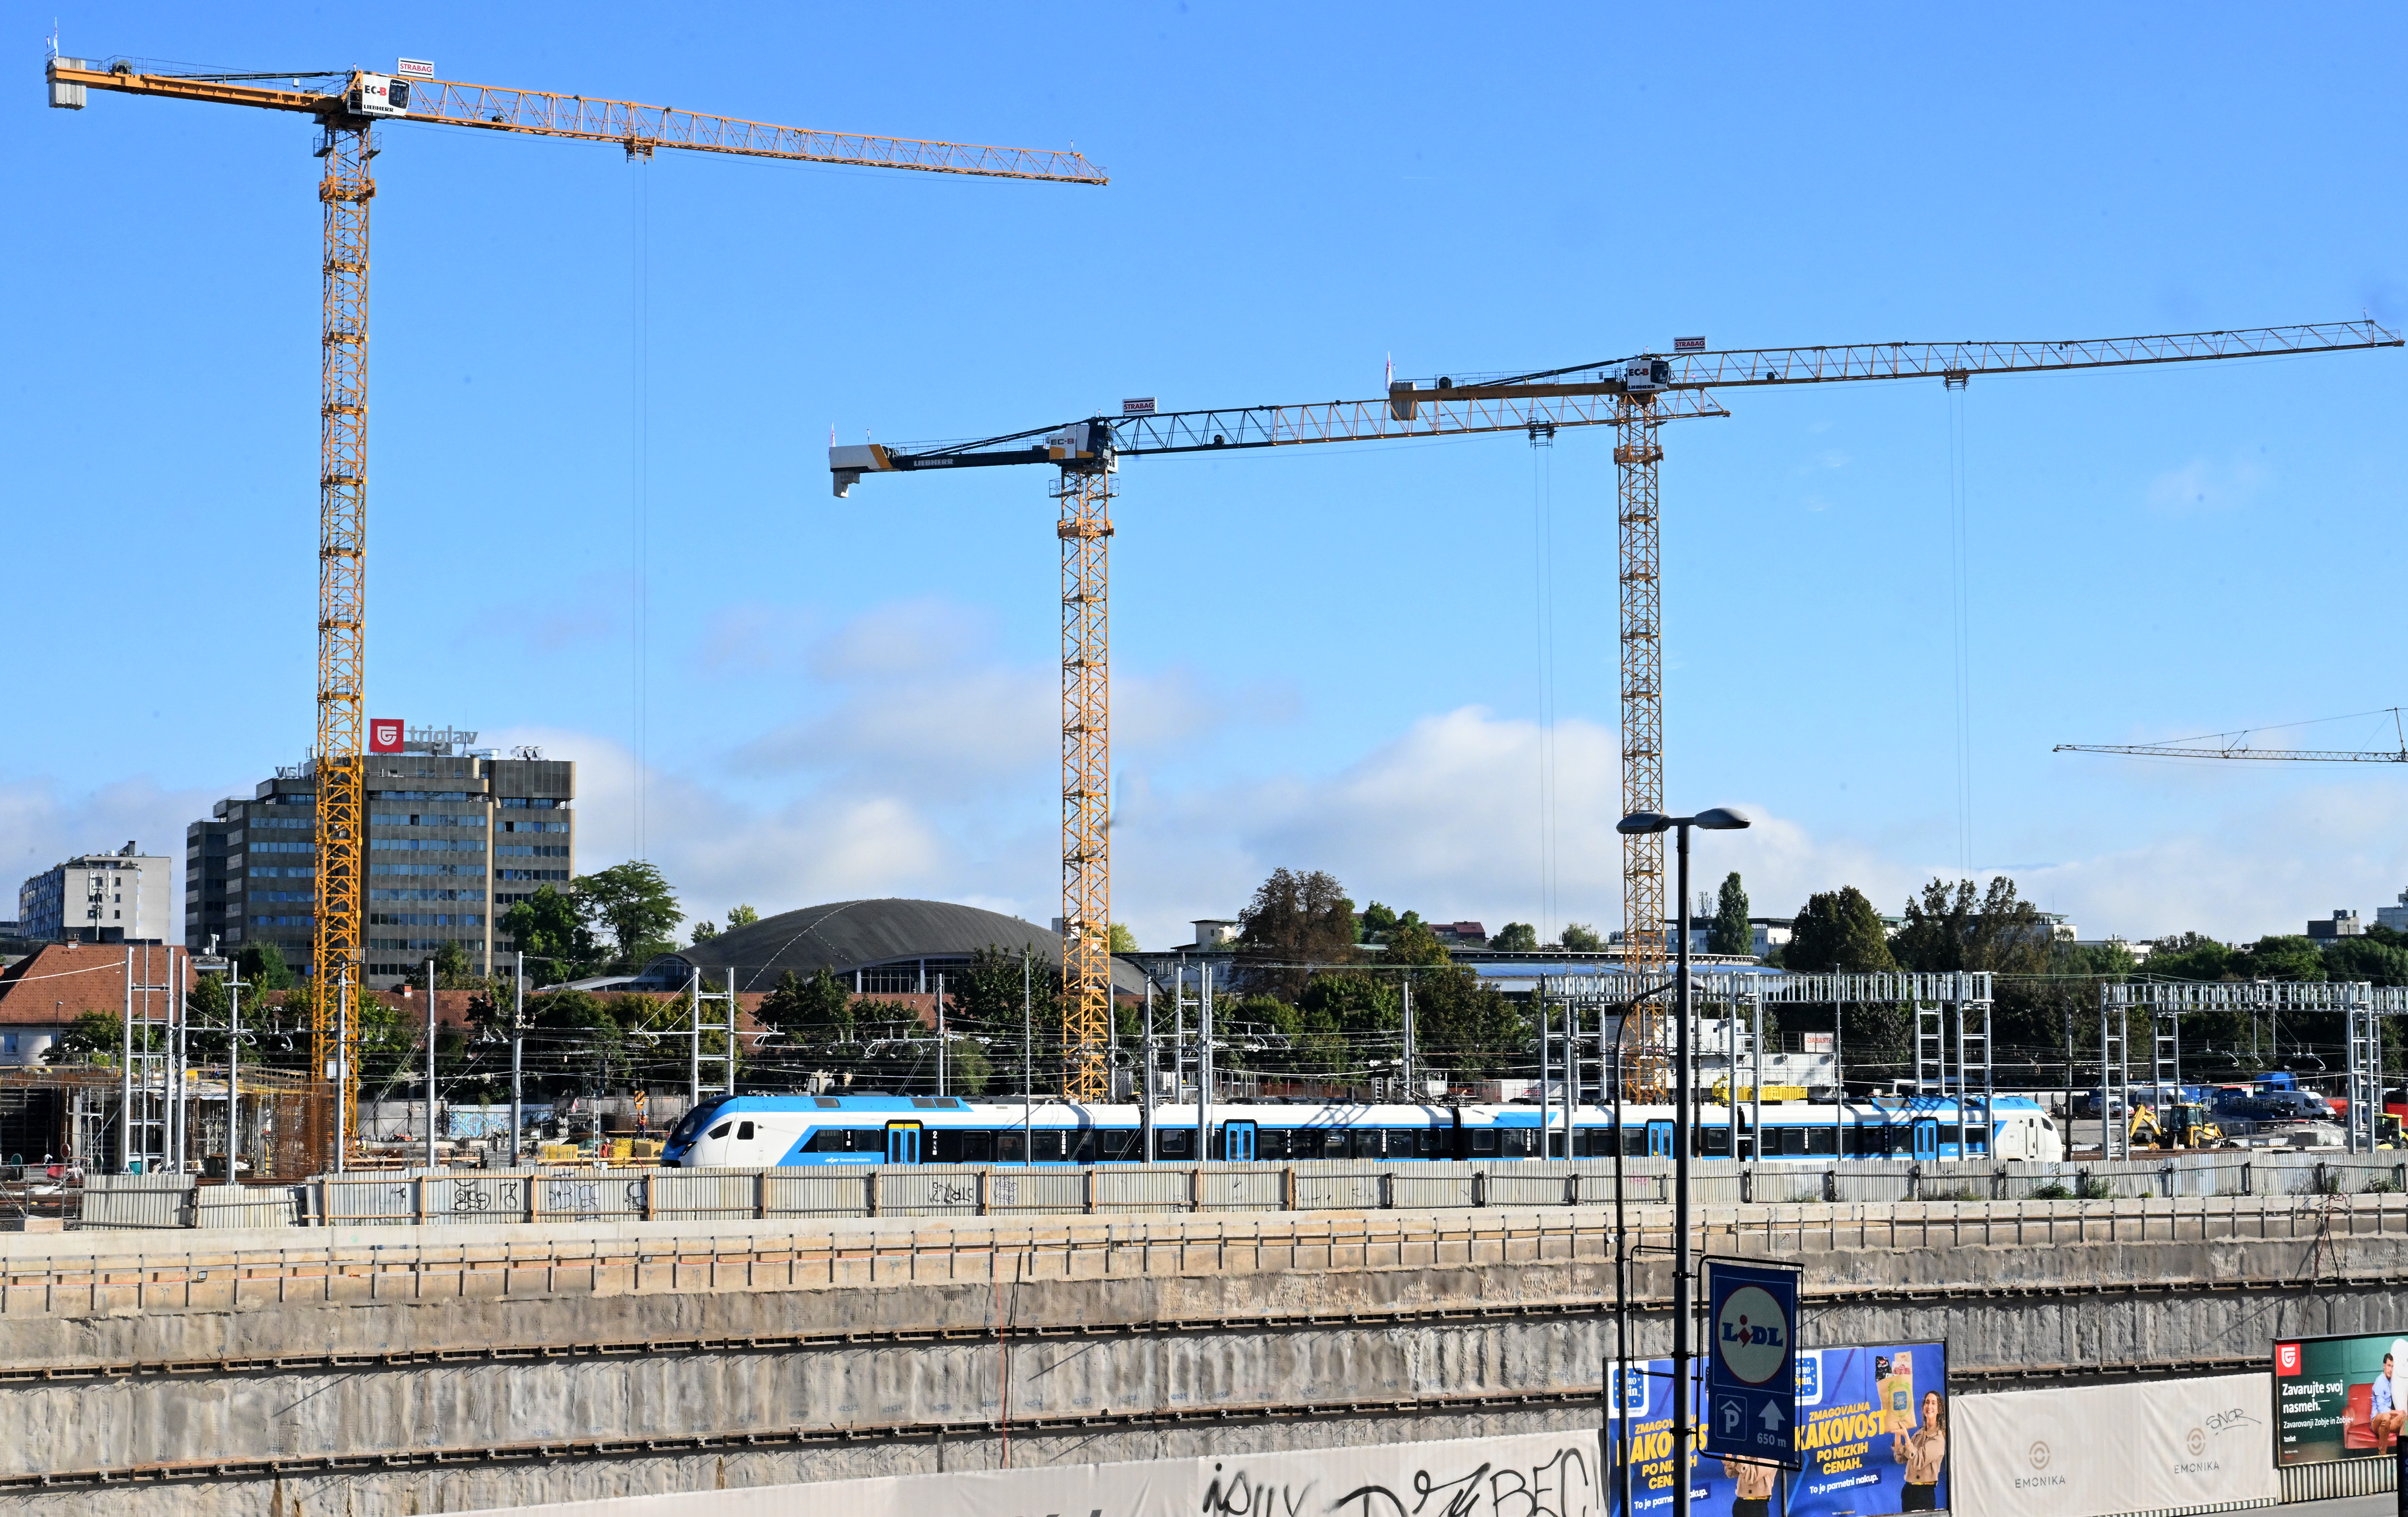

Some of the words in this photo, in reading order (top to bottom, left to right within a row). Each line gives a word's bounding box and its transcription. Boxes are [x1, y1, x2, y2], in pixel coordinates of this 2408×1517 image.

[400, 63, 432, 73] STRABAG
[365, 85, 387, 96] EC-B
[363, 104, 394, 112] LIEBHERR
[1628, 368, 1649, 377] EC-B
[1124, 402, 1154, 410] STRABAG
[913, 458, 953, 467] LIEBHERR
[408, 724, 479, 750] triglav
[847, 1131, 851, 1139] 1
[932, 1131, 937, 1139] 2
[1061, 1130, 1066, 1138] 2
[2282, 1381, 2324, 1398] Zavarujte
[2326, 1379, 2343, 1395] svoj
[1809, 1402, 1870, 1422] ZMAGOVALNA
[2283, 1398, 2321, 1414] nasmeh.
[1724, 1409, 1739, 1433] P
[2283, 1418, 2314, 1429] Zavarovanji
[2315, 1417, 2329, 1428] Zobje
[2336, 1416, 2354, 1425] Zobje+
[1795, 1409, 1887, 1452] KAKOVOST
[1757, 1433, 1775, 1446] 650
[1777, 1437, 1787, 1448] m
[1817, 1449, 1832, 1463] PO
[1833, 1441, 1868, 1459] NIZKIH
[1642, 1464, 1659, 1477] PO
[1823, 1457, 1863, 1475] CENAH.
[2174, 1461, 2220, 1475] EMONIKA
[1809, 1485, 1818, 1494] To
[1819, 1483, 1825, 1495] je
[1827, 1477, 1855, 1493] pametni
[1855, 1473, 1879, 1484] nakup.
[2015, 1474, 2066, 1488] EMONIKA
[1634, 1501, 1643, 1509] To
[1644, 1499, 1651, 1510] je
[1689, 1488, 1707, 1499] akup.
